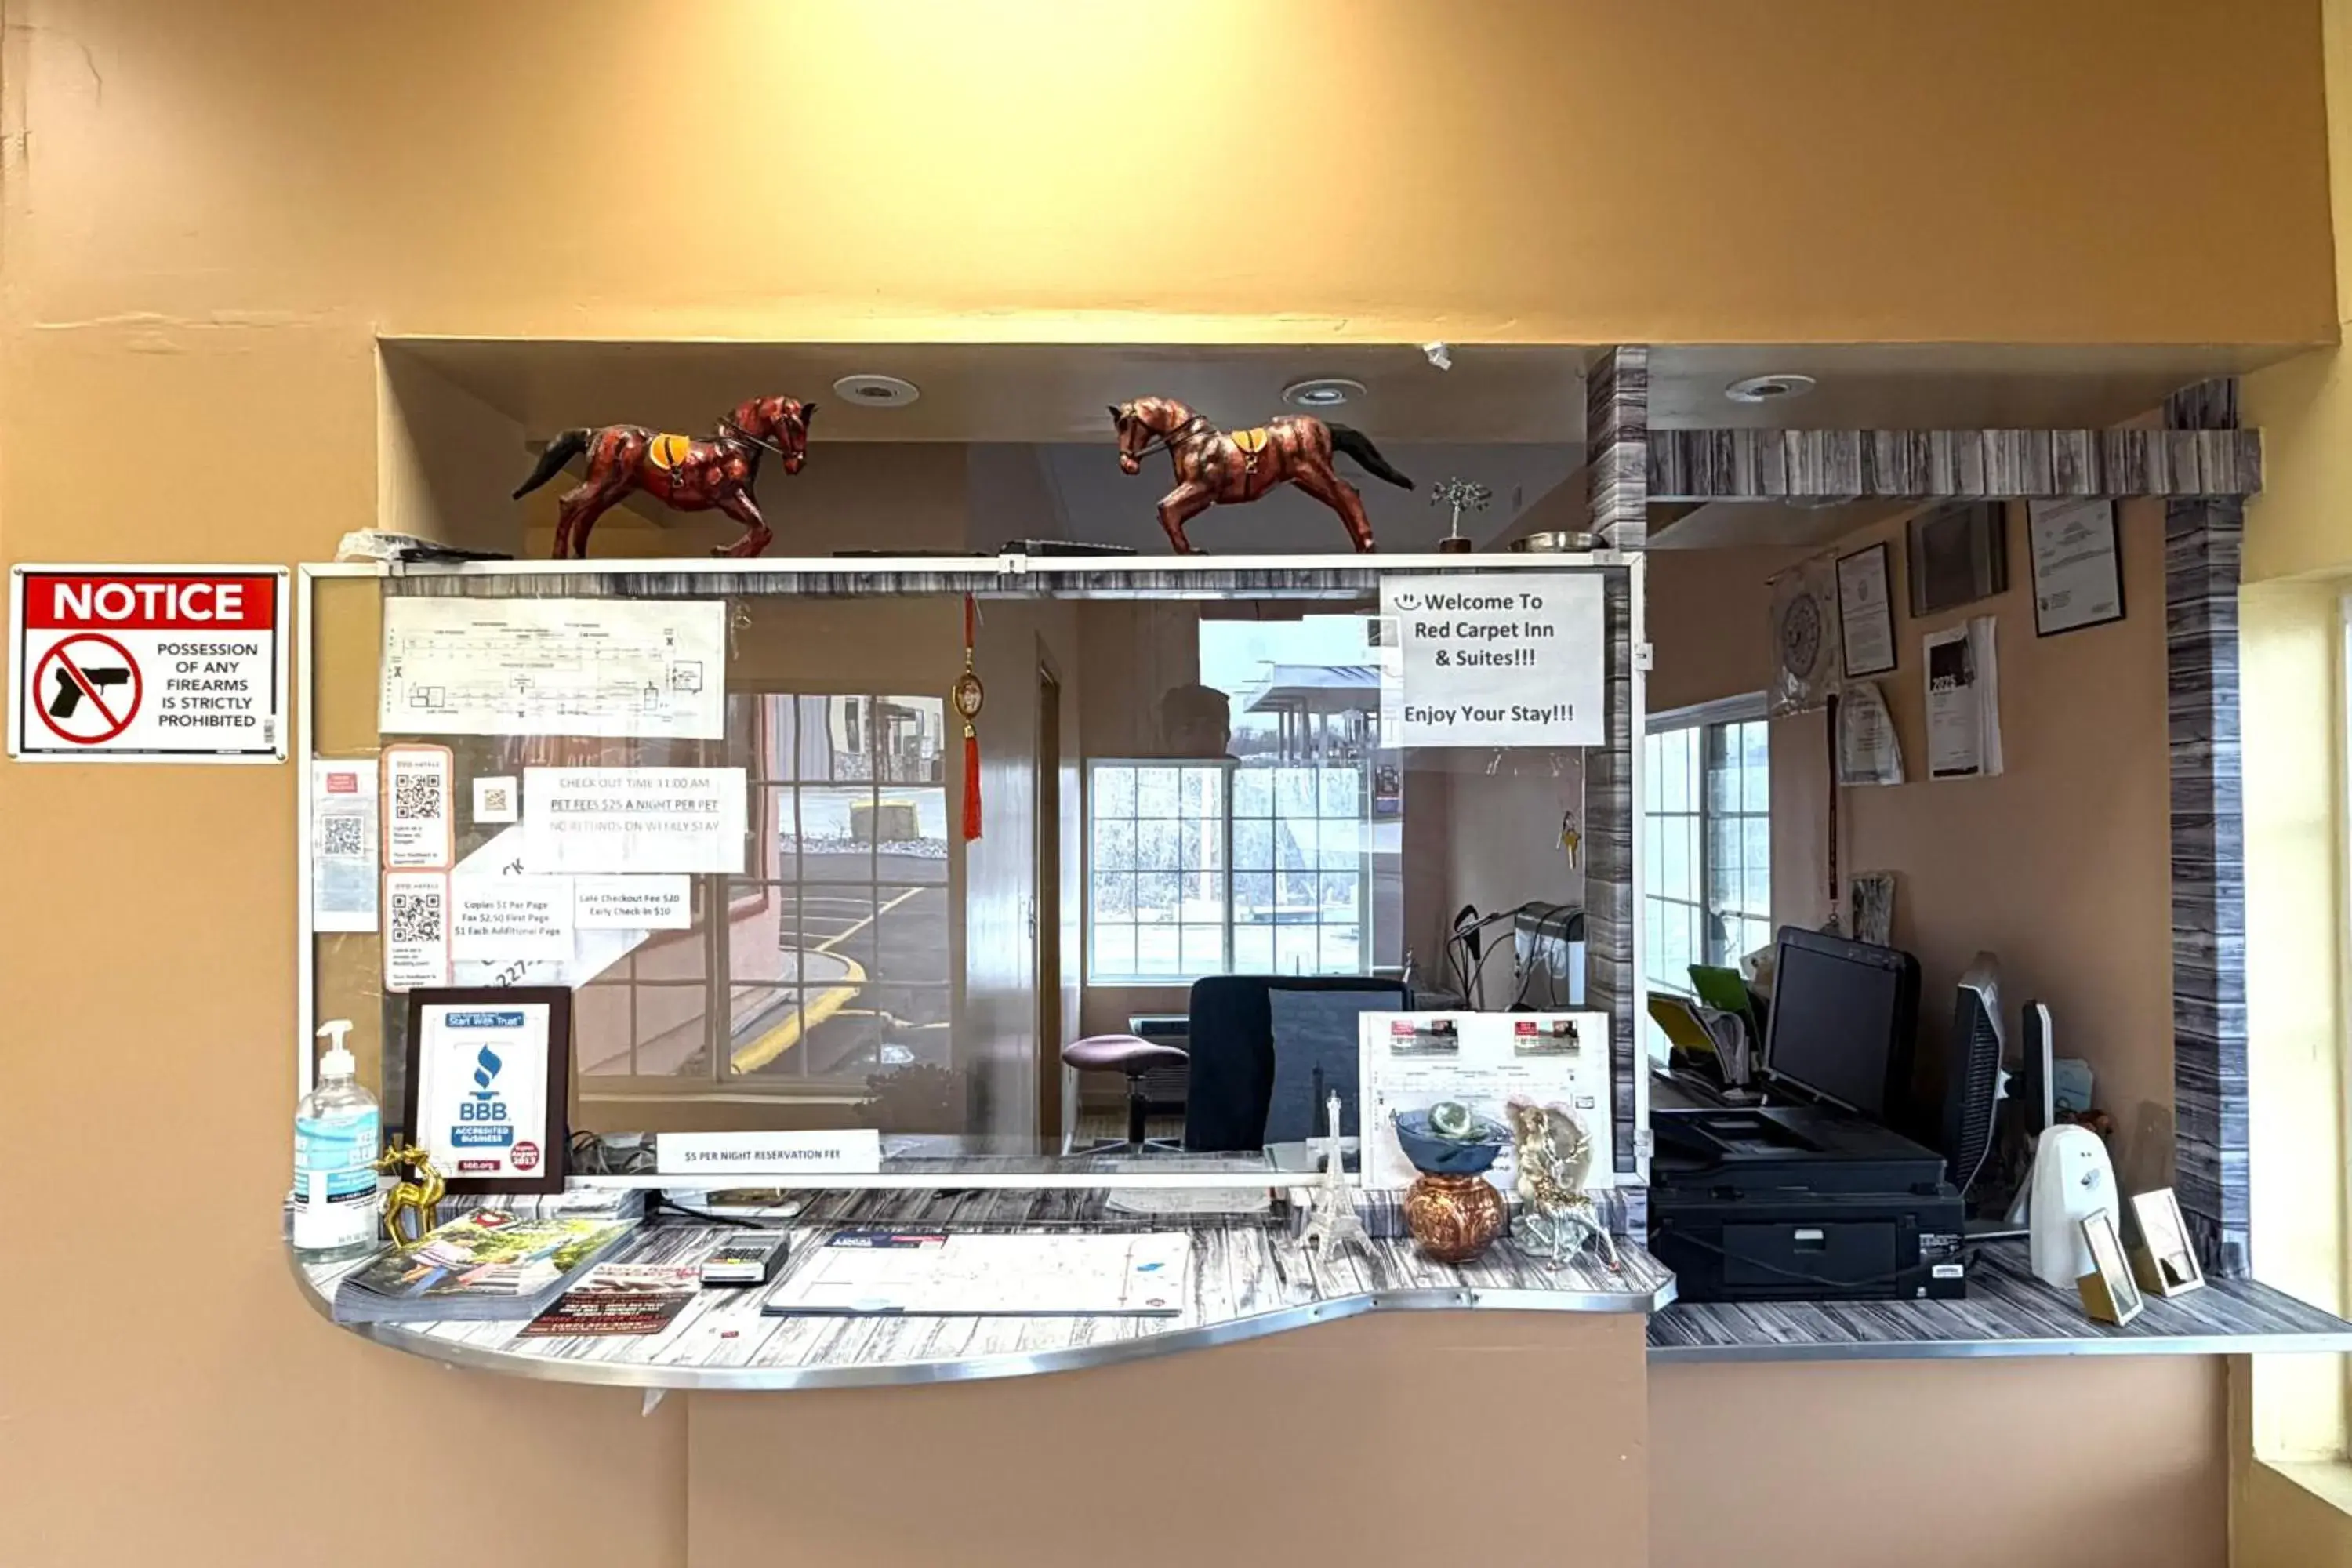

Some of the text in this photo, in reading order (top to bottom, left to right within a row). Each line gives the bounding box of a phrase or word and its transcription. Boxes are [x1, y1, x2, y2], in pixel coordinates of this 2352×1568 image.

[53, 583, 244, 621] NOTICE
[1425, 593, 1543, 610] Welcome To
[1415, 622, 1555, 641] Red Carpet Inn
[157, 644, 258, 655] POSSESSION
[1436, 648, 1535, 666] & Suites!!!
[176, 662, 239, 673] OF ANY
[167, 679, 249, 691] FIREARMS
[162, 697, 252, 710] IS STRICTLY
[1405, 705, 1573, 725] Enjoy Your Stay!!!
[158, 715, 256, 728] PROHIBITED
[560, 778, 710, 789] CHECK OUT TIME 11:00 AM
[551, 799, 717, 811] PET FEES $25 A NIGHT PER PET
[550, 821, 566, 832] NO
[625, 821, 642, 832] ON
[691, 821, 719, 832] STAY
[579, 894, 598, 902] Late
[601, 894, 642, 902] Checkout
[644, 894, 660, 902] Fee
[464, 901, 494, 910] Copies
[510, 901, 524, 909] Per
[527, 901, 548, 910] Page
[590, 907, 611, 916] Early
[654, 907, 671, 916] $10
[462, 913, 550, 924] Fax $2.50 First Page
[468, 926, 488, 935] Each
[492, 926, 536, 935] Additional
[539, 927, 561, 936] Page
[460, 1102, 506, 1120] BBB
[684, 1149, 840, 1162] $5 PER NIGHT RESERVATION FEE
